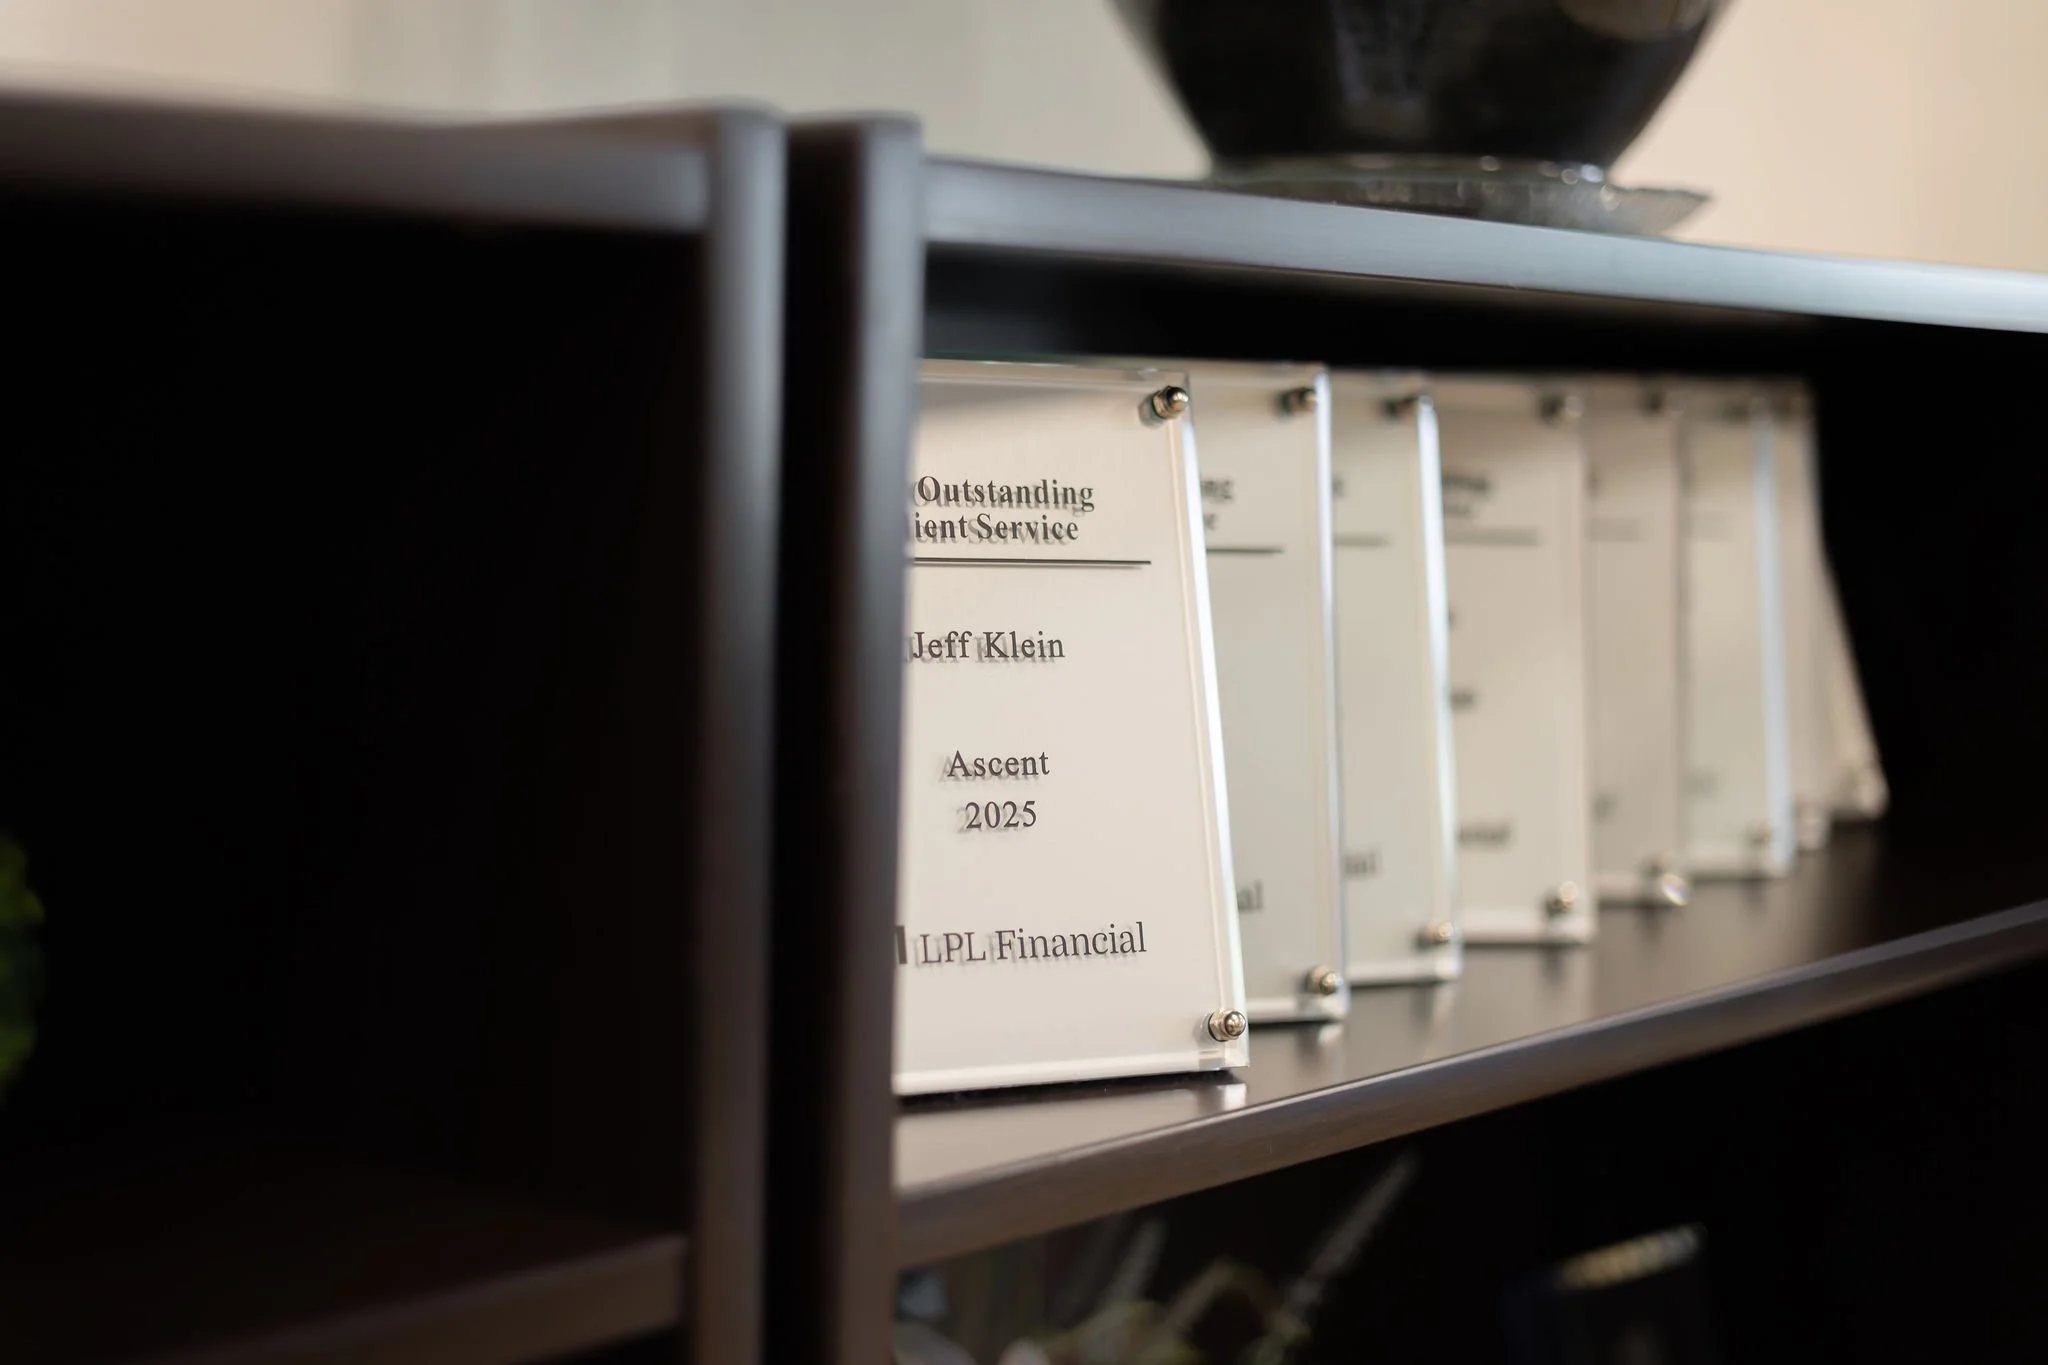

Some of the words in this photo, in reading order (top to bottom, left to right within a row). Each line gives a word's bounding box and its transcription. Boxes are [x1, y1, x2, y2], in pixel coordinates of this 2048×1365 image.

[917, 476, 1095, 512] Outstanding
[913, 512, 968, 539] ient
[976, 513, 1079, 540] Service
[912, 631, 973, 658] Jeff
[982, 631, 1065, 658] Klein
[947, 750, 1050, 777] Ascent
[965, 800, 1037, 829] 2025
[920, 932, 986, 964] LPL
[996, 921, 1147, 961] Financial
